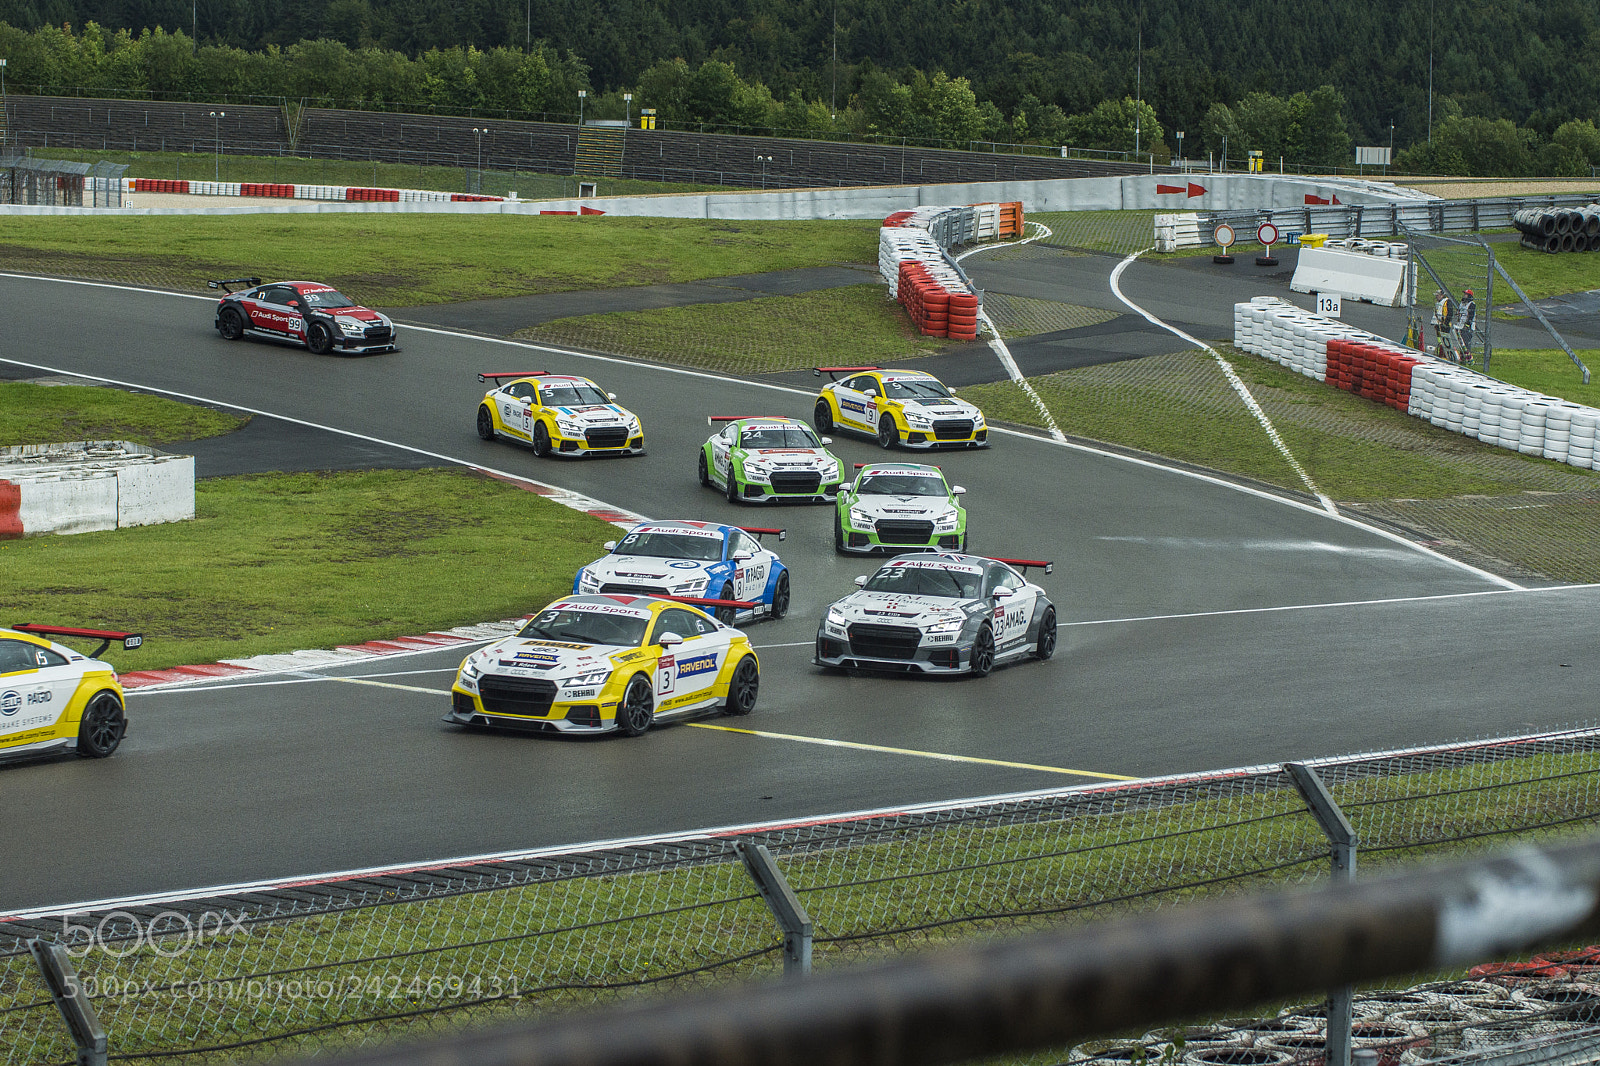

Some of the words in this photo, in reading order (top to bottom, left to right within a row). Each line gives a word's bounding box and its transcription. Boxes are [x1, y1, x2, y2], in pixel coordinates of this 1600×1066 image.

[303, 294, 320, 302] 99
[1319, 298, 1338, 312] 13a
[272, 314, 289, 323] Sport
[289, 318, 301, 330] 99
[892, 382, 903, 390] 9
[545, 389, 555, 397] 5
[868, 410, 874, 421] 9
[525, 417, 530, 429] 5
[743, 431, 764, 440] 24
[863, 477, 873, 486] 7
[680, 529, 715, 537] Sport
[623, 535, 639, 544] 8
[937, 563, 974, 572] Sport
[876, 568, 906, 578] 23
[737, 581, 743, 596] 8
[568, 603, 599, 611] Audi
[601, 605, 641, 616] Sport
[541, 611, 560, 622] 3
[995, 619, 1004, 636] 23
[934, 634, 954, 643] REHAU
[518, 653, 556, 661] RAVENOL
[680, 660, 715, 675] RAVENOL
[663, 671, 670, 689] 3
[27, 690, 53, 705] PAGID
[572, 688, 596, 698] REHAU
